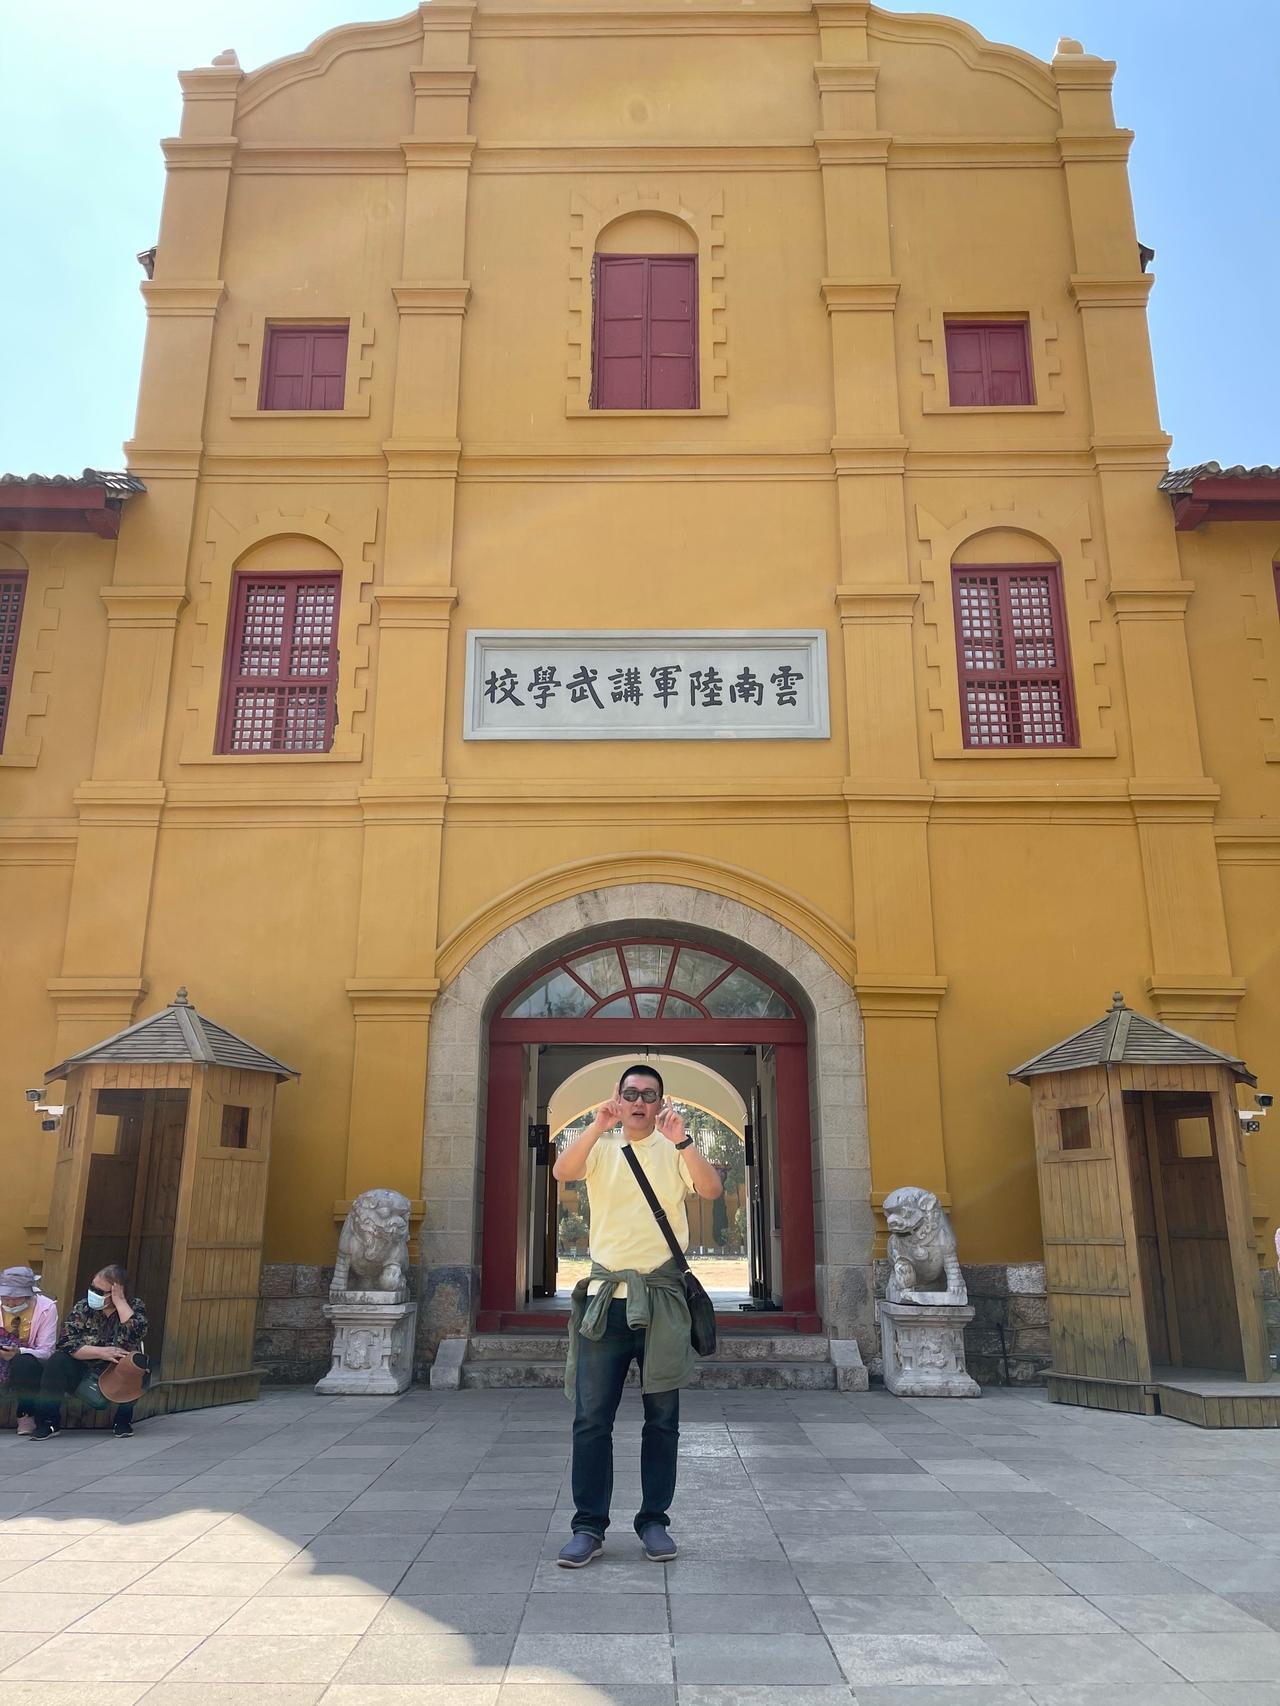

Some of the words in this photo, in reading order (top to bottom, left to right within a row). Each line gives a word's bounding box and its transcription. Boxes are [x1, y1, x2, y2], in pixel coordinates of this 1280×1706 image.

[484, 665, 804, 709] 雲南陸軍講武學校
